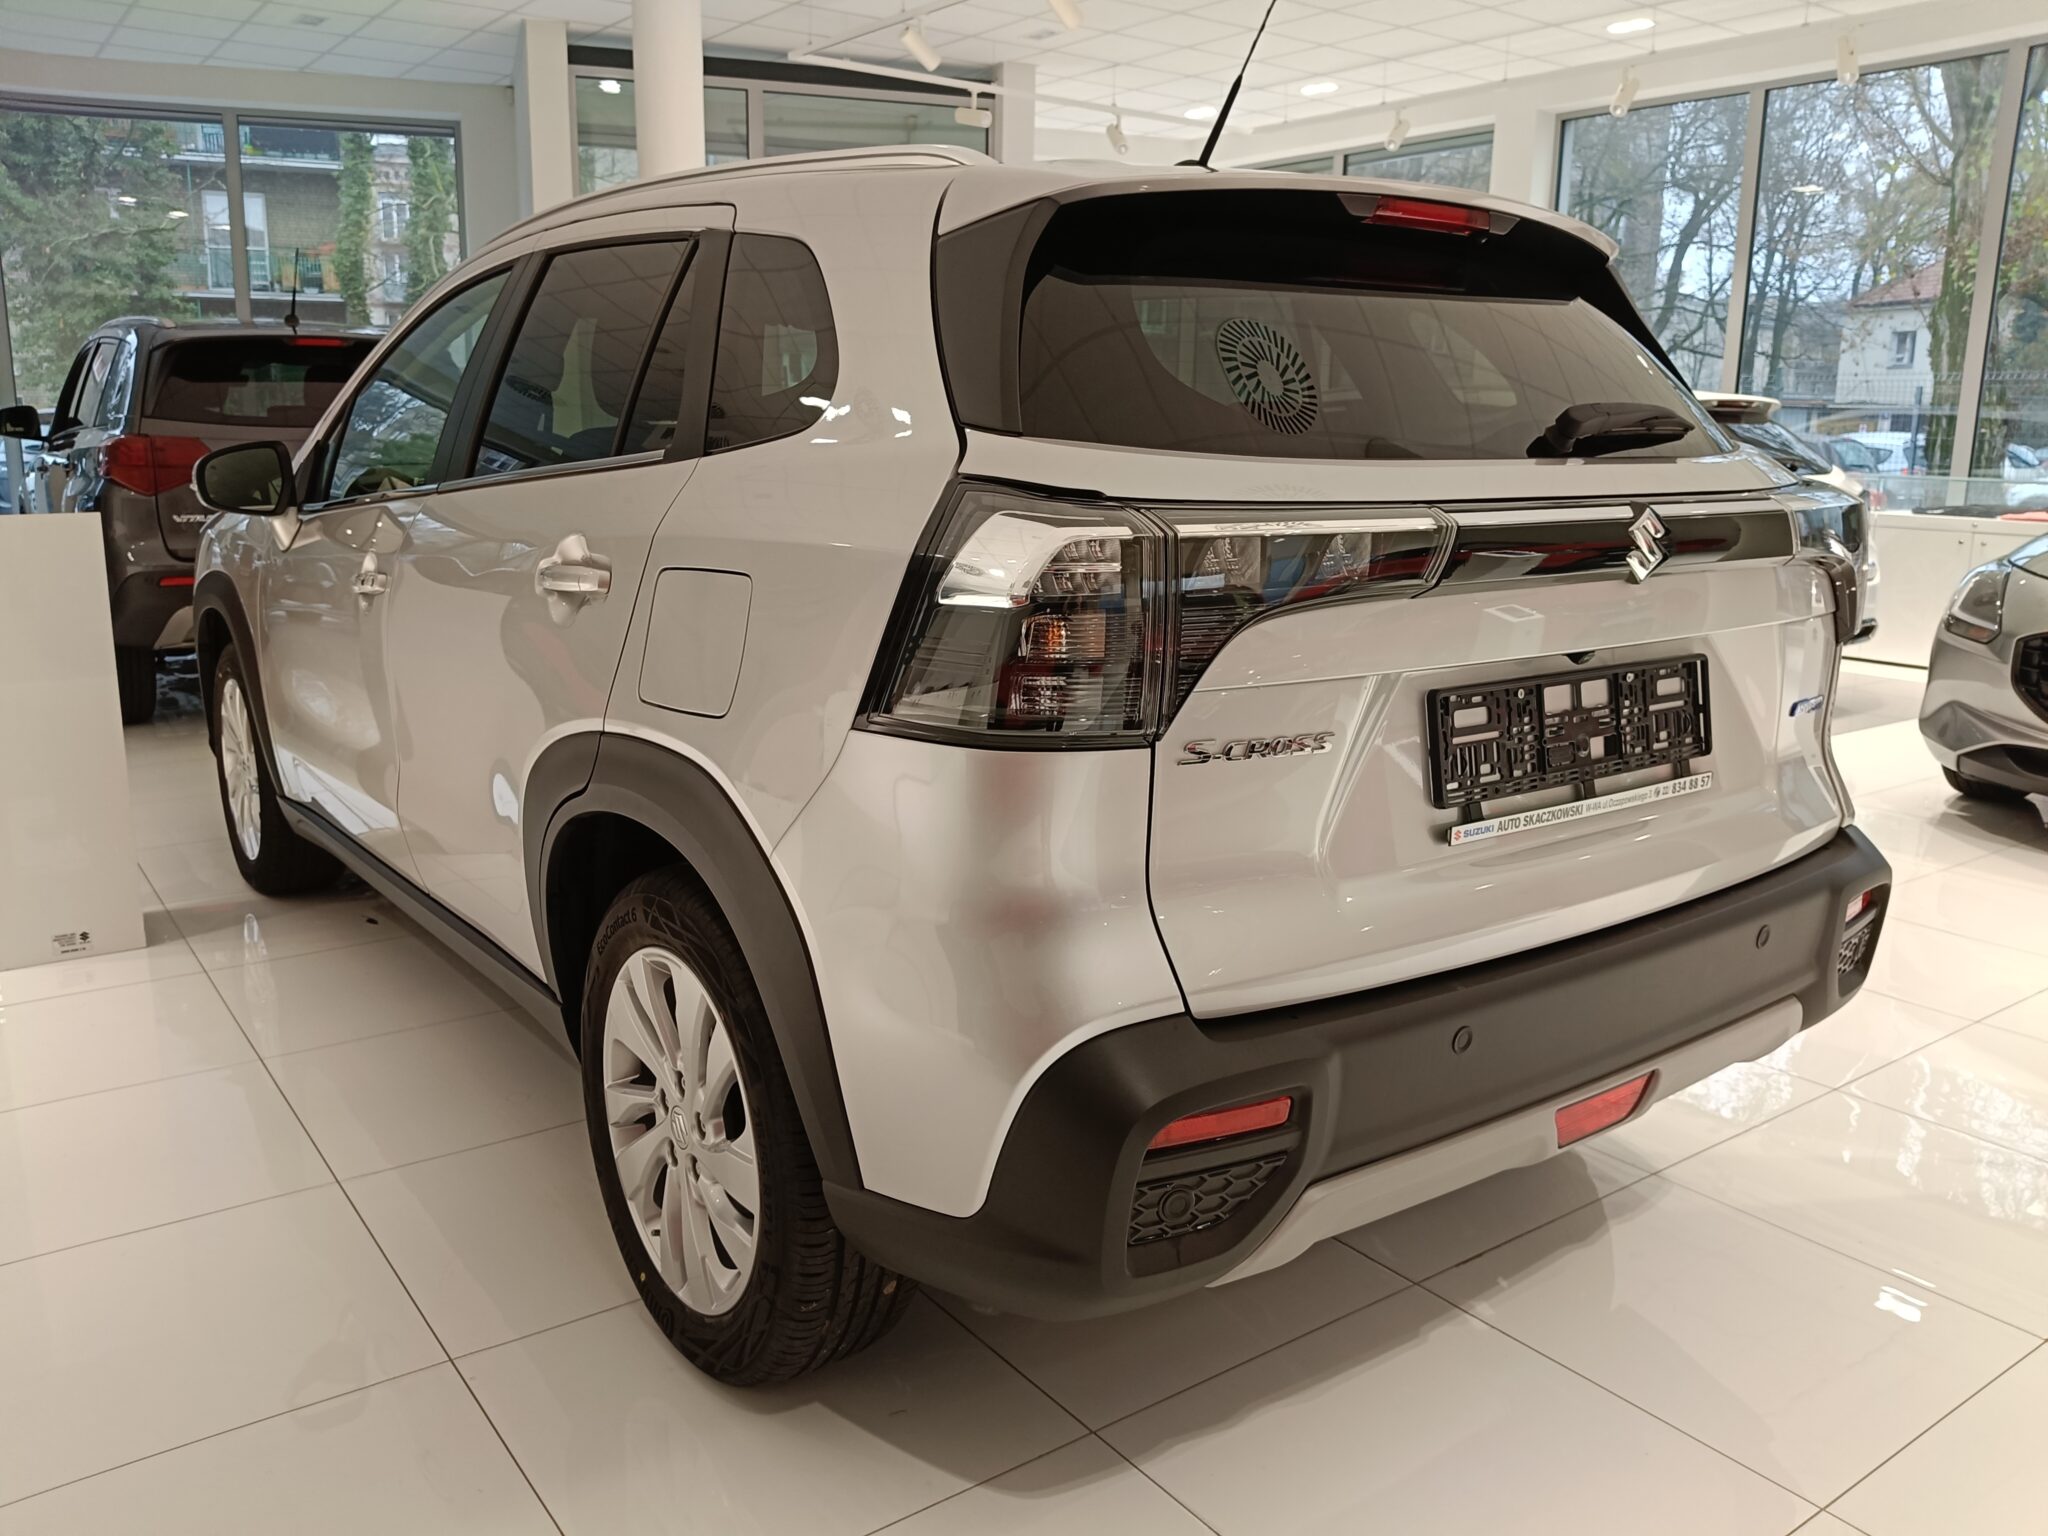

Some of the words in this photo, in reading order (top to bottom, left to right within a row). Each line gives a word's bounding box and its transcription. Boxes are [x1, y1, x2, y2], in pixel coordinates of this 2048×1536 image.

[1177, 731, 1335, 766] S-CROSS
[1463, 824, 1495, 838] SUZUKI
[1497, 817, 1521, 833] AUTO
[1522, 804, 1584, 827] SKACZKOWSKI
[1671, 780, 1687, 795] 834
[1688, 777, 1698, 791] 88
[1700, 775, 1711, 788] 57
[596, 909, 632, 957] EcoContact
[631, 906, 637, 922] 6
